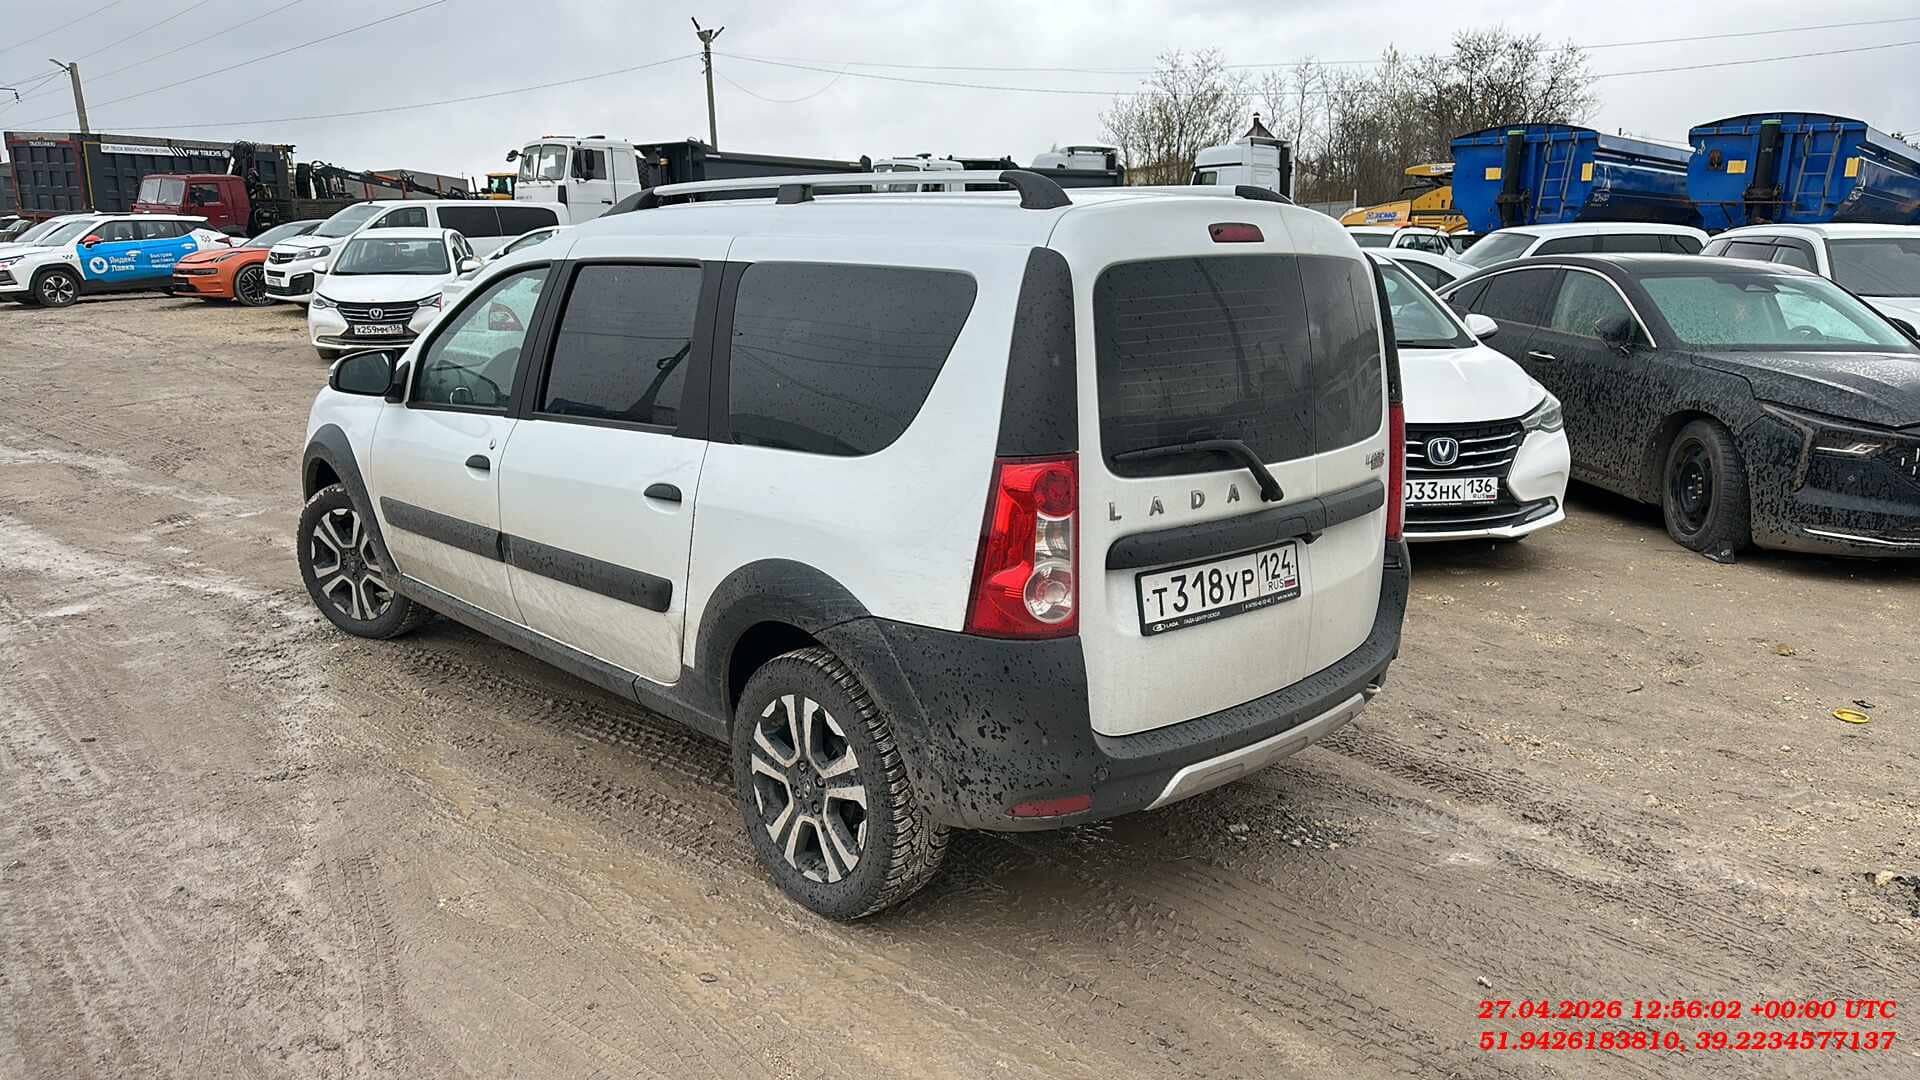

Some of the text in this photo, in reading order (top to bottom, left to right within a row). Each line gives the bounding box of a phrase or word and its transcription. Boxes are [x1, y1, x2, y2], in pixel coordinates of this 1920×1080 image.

[109, 256, 137, 264] Яндекс
[112, 264, 136, 272] Лавка
[1467, 480, 1492, 494] 136
[1108, 484, 1240, 522] LADA
[1152, 550, 1291, 617] Т318УР 124
[1268, 578, 1284, 592] RUS
